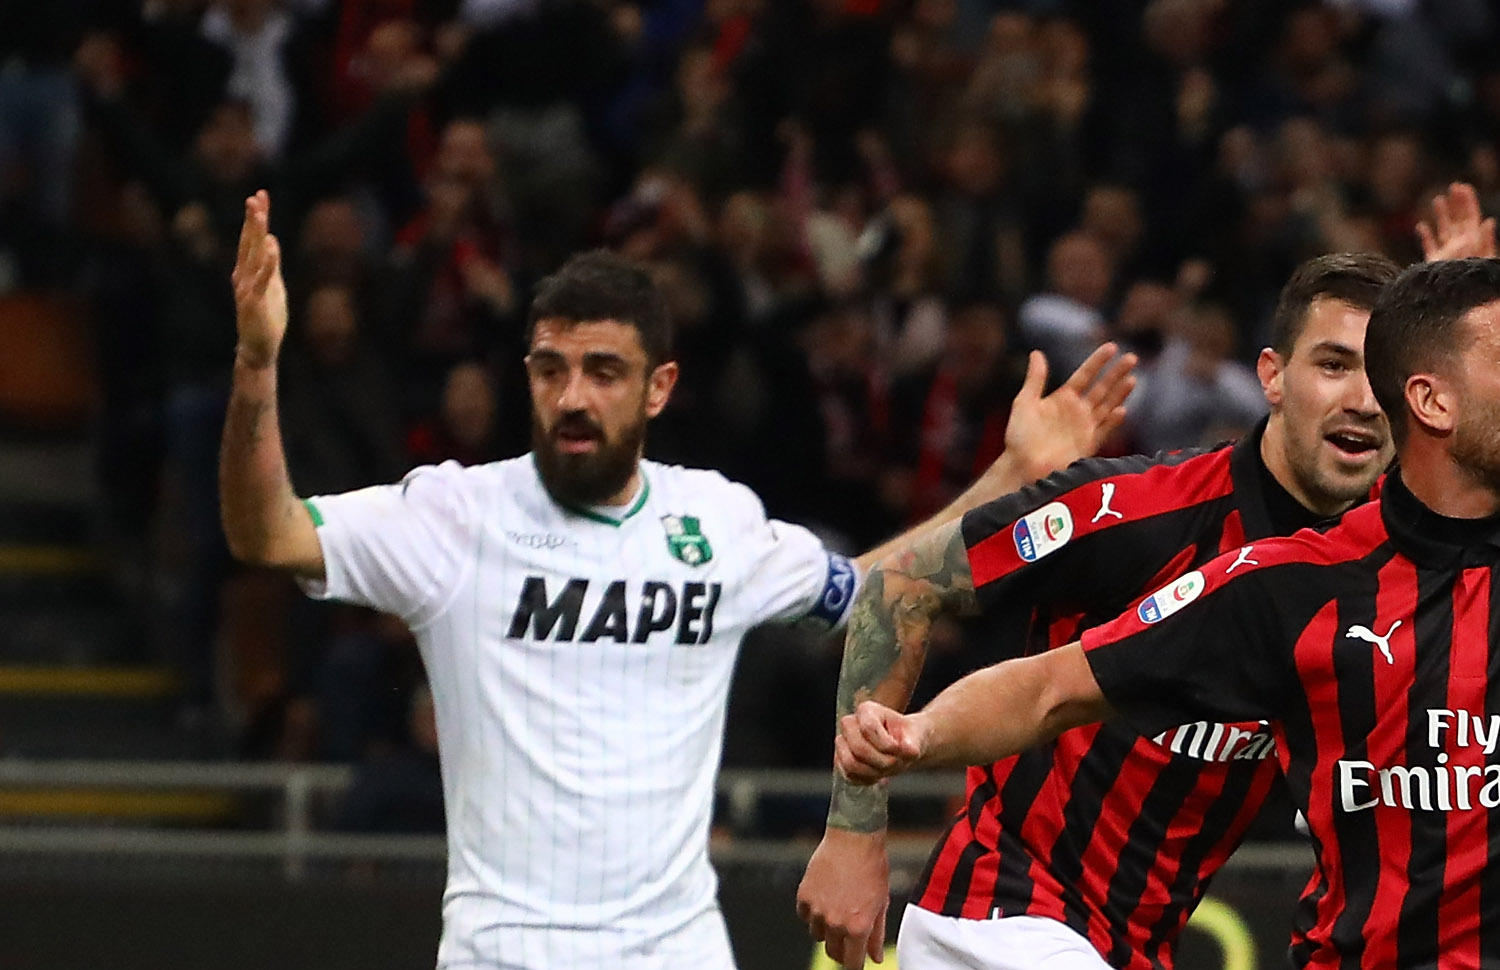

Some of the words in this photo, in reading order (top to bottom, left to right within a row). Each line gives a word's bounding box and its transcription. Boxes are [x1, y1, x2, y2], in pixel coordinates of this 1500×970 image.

[1020, 535, 1034, 558] TIM
[505, 576, 722, 645] MAPEI
[1153, 720, 1278, 763] mira
[1427, 709, 1500, 755] Fly
